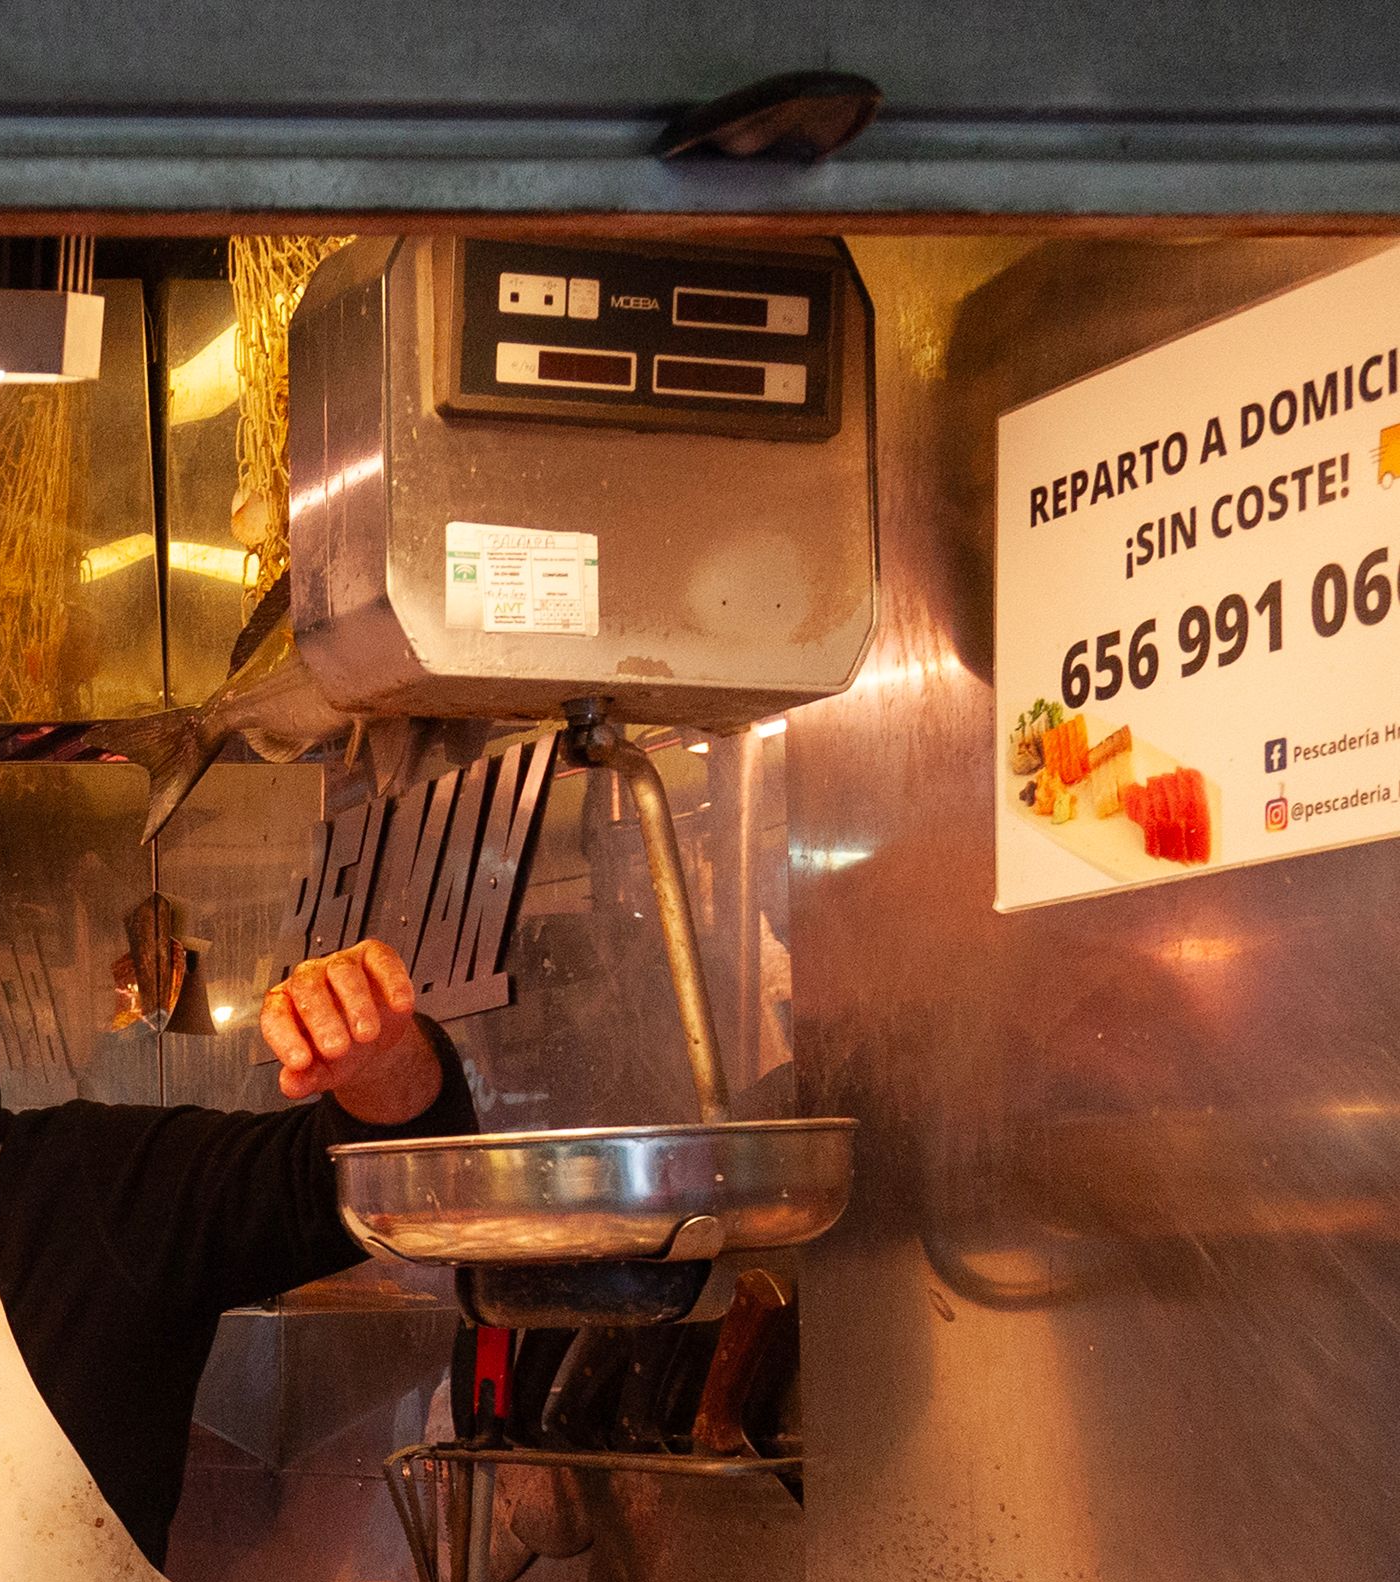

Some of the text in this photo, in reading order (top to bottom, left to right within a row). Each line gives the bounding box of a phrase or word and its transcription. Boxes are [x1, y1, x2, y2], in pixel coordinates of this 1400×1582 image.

[1030, 430, 1188, 528] REPARTO
[1200, 417, 1225, 464] A
[1125, 452, 1352, 579] ¡SIN COSTE!
[1061, 617, 1160, 709] 656
[1178, 579, 1283, 678] 991
[1291, 780, 1400, 822] @pescaderia_
[1294, 728, 1380, 763] Pescadería
